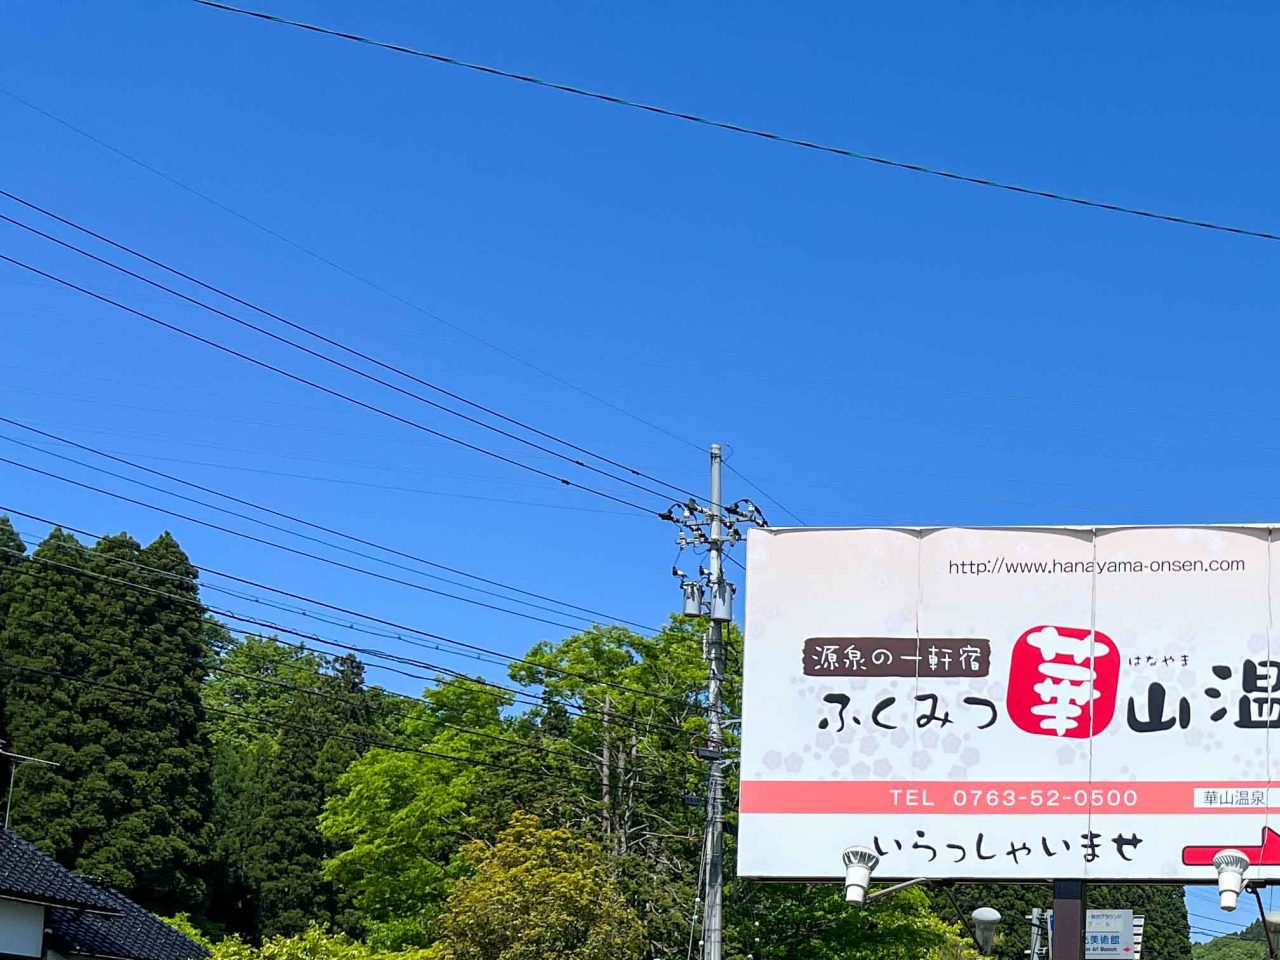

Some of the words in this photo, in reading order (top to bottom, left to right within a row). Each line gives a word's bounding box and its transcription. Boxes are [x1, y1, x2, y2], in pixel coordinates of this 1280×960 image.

[949, 556, 1246, 576] http://www.hanayama-onsen.com
[812, 644, 982, 672] 源泉の一軒宿
[1128, 654, 1189, 667] はなやま
[889, 789, 935, 806] TEL
[953, 789, 1138, 807] 0763-52-0500
[1203, 790, 1266, 806] 華山温泉
[873, 830, 1144, 865] いらっしゃいませ
